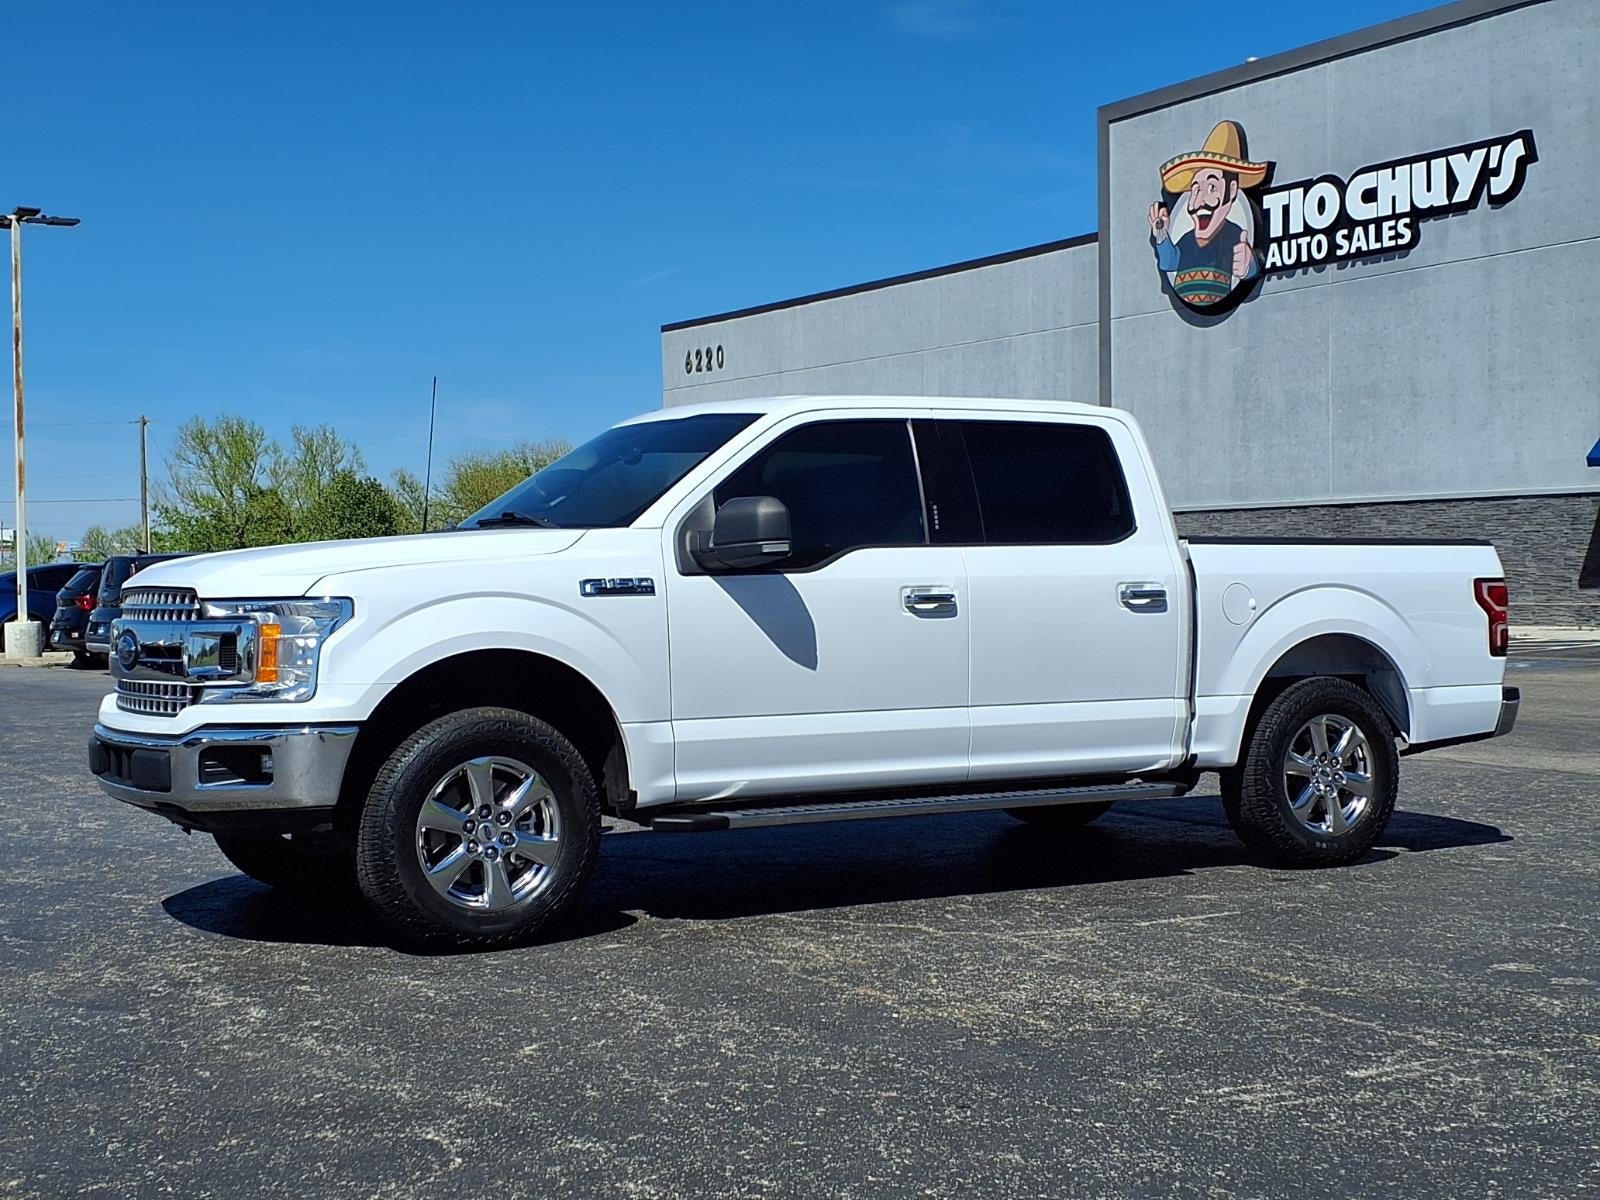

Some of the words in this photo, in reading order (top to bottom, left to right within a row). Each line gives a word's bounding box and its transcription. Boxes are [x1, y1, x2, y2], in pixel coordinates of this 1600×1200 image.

[1263, 183, 1340, 237] TIO
[1345, 138, 1525, 220] CHUY'S
[1266, 236, 1328, 268] AUTO
[1336, 218, 1411, 255] SALES
[685, 344, 724, 374] 6220
